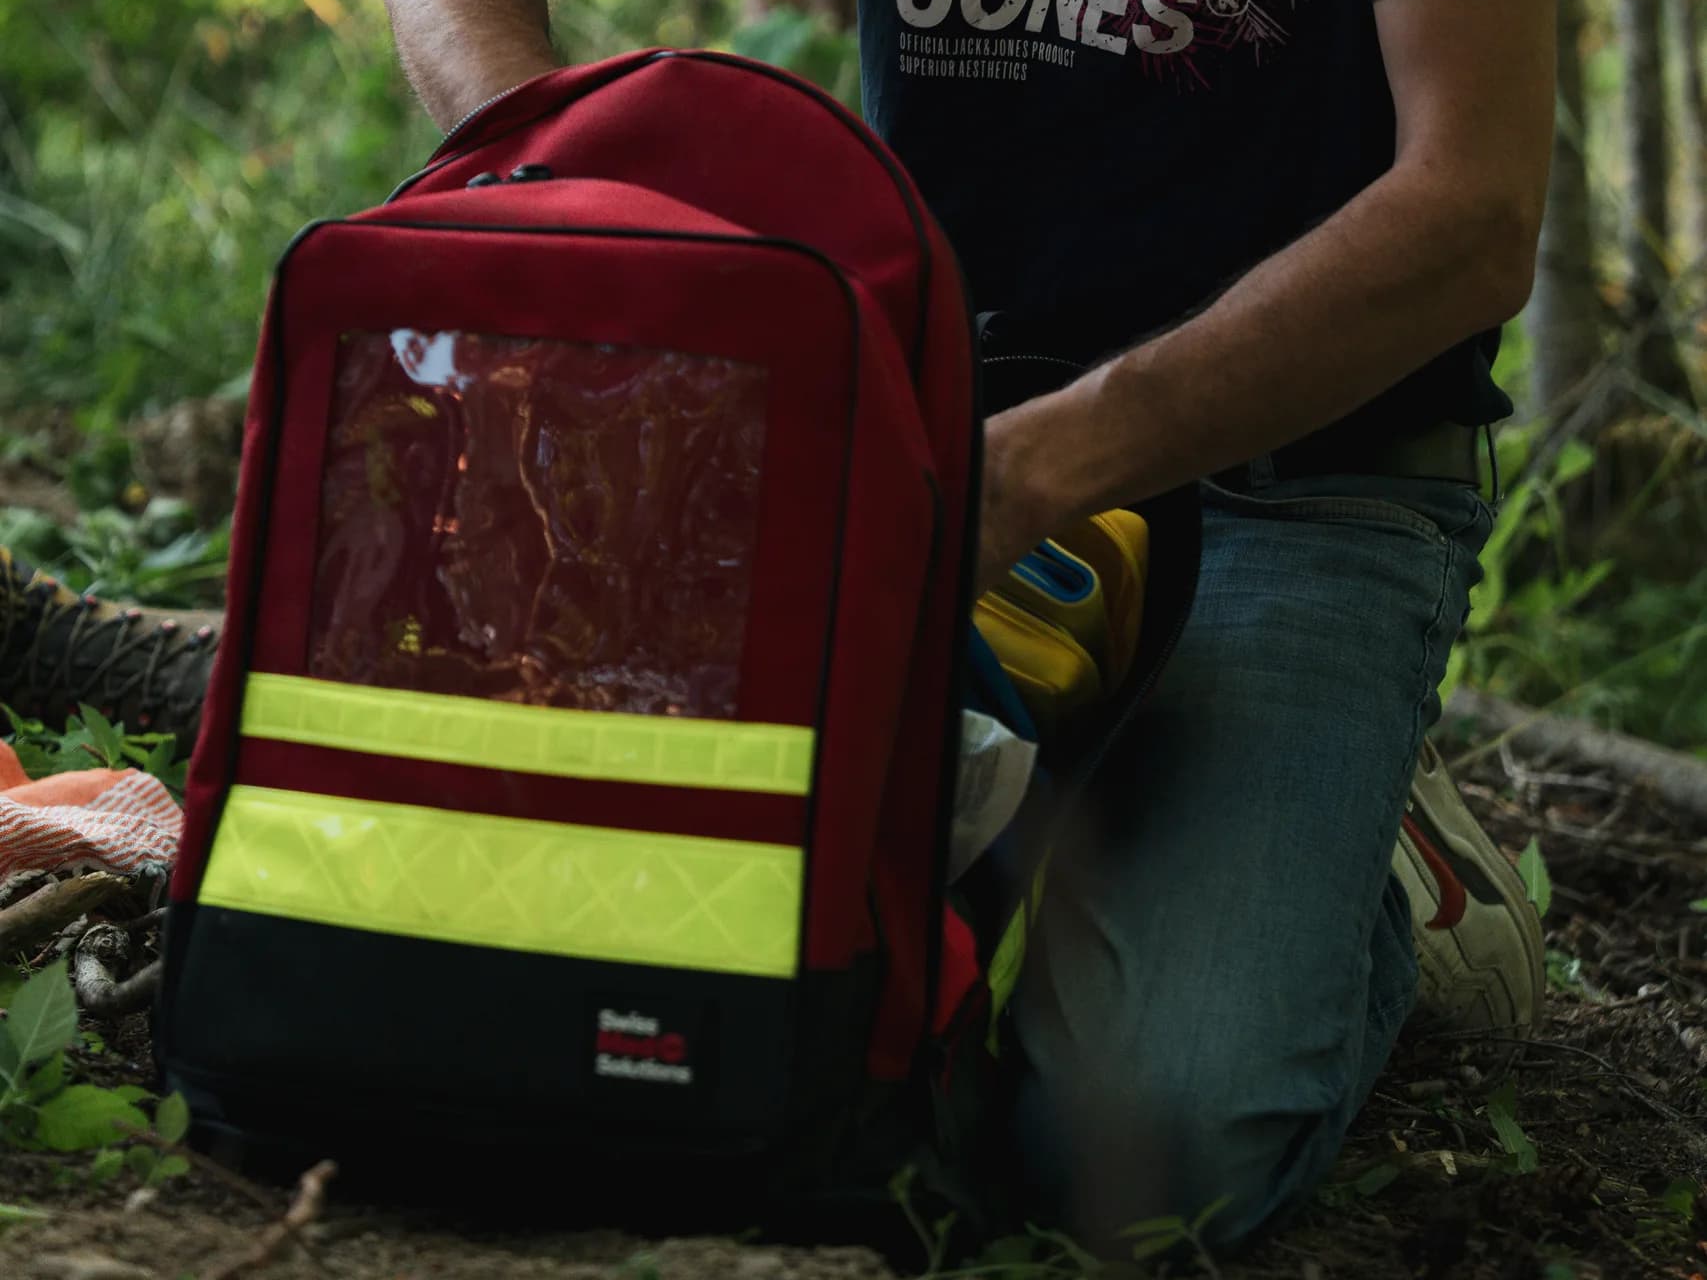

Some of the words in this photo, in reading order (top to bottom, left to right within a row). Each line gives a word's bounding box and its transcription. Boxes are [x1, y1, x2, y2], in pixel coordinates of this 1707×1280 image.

[899, 53, 955, 77] SUPERIOR
[958, 60, 1028, 81] AESTHETICS
[1031, 40, 1076, 69] PRODUCT
[598, 1007, 660, 1035] Swiss
[595, 1052, 694, 1084] Solutions
